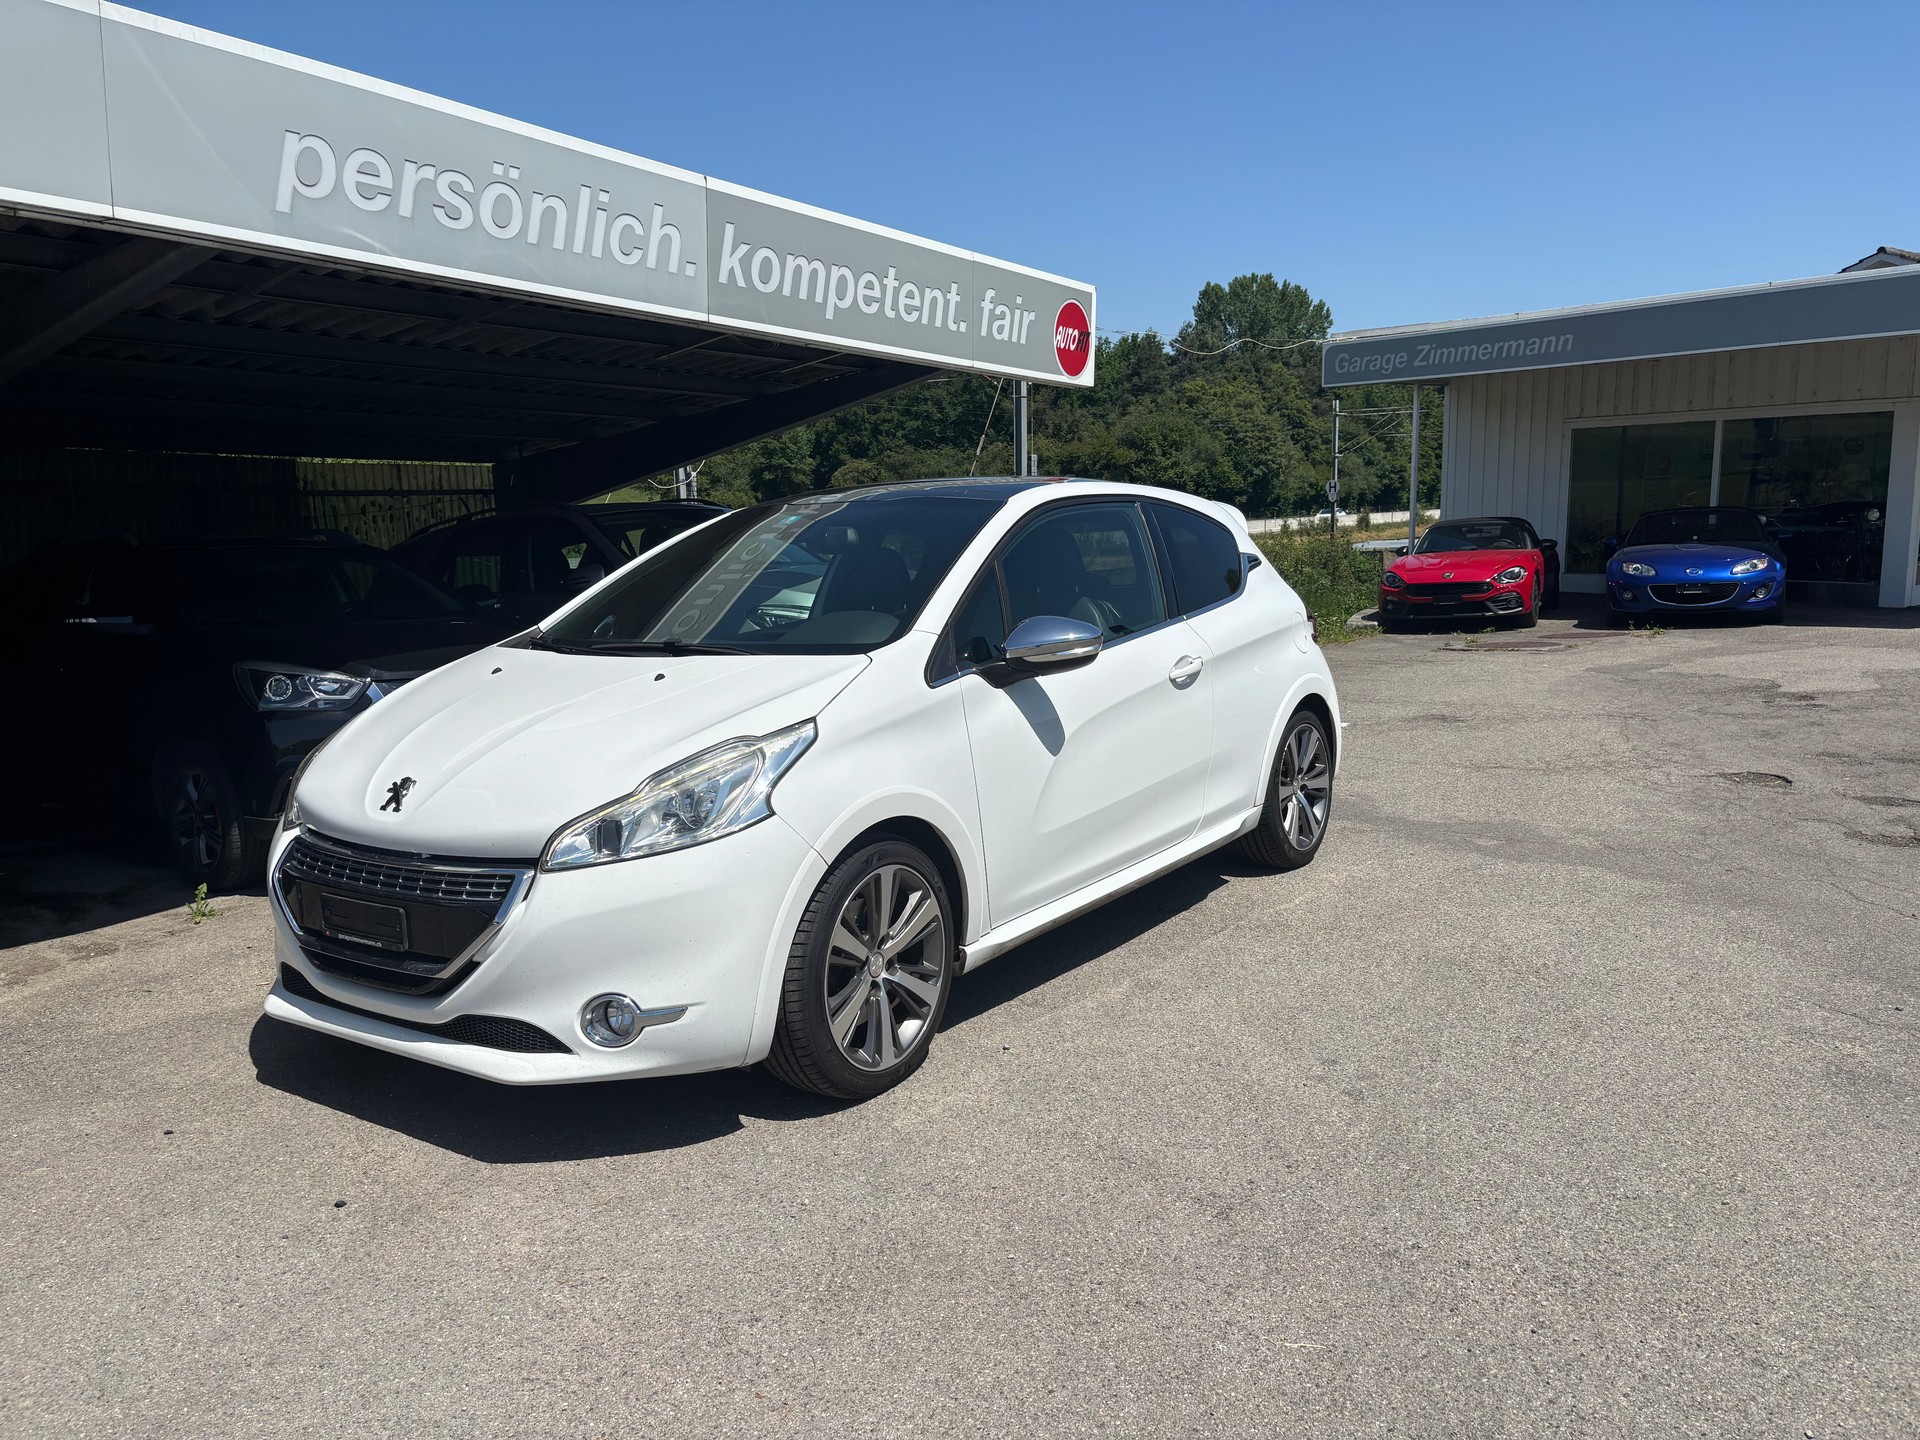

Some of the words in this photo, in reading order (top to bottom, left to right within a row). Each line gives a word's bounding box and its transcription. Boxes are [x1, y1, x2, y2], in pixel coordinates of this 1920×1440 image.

[274, 129, 697, 277] persönlich.
[718, 221, 967, 333] kompetent.
[980, 287, 1036, 345] fair
[1334, 351, 1408, 375] Garage
[1413, 334, 1574, 367] Zimmermann
[1329, 481, 1336, 493] H
